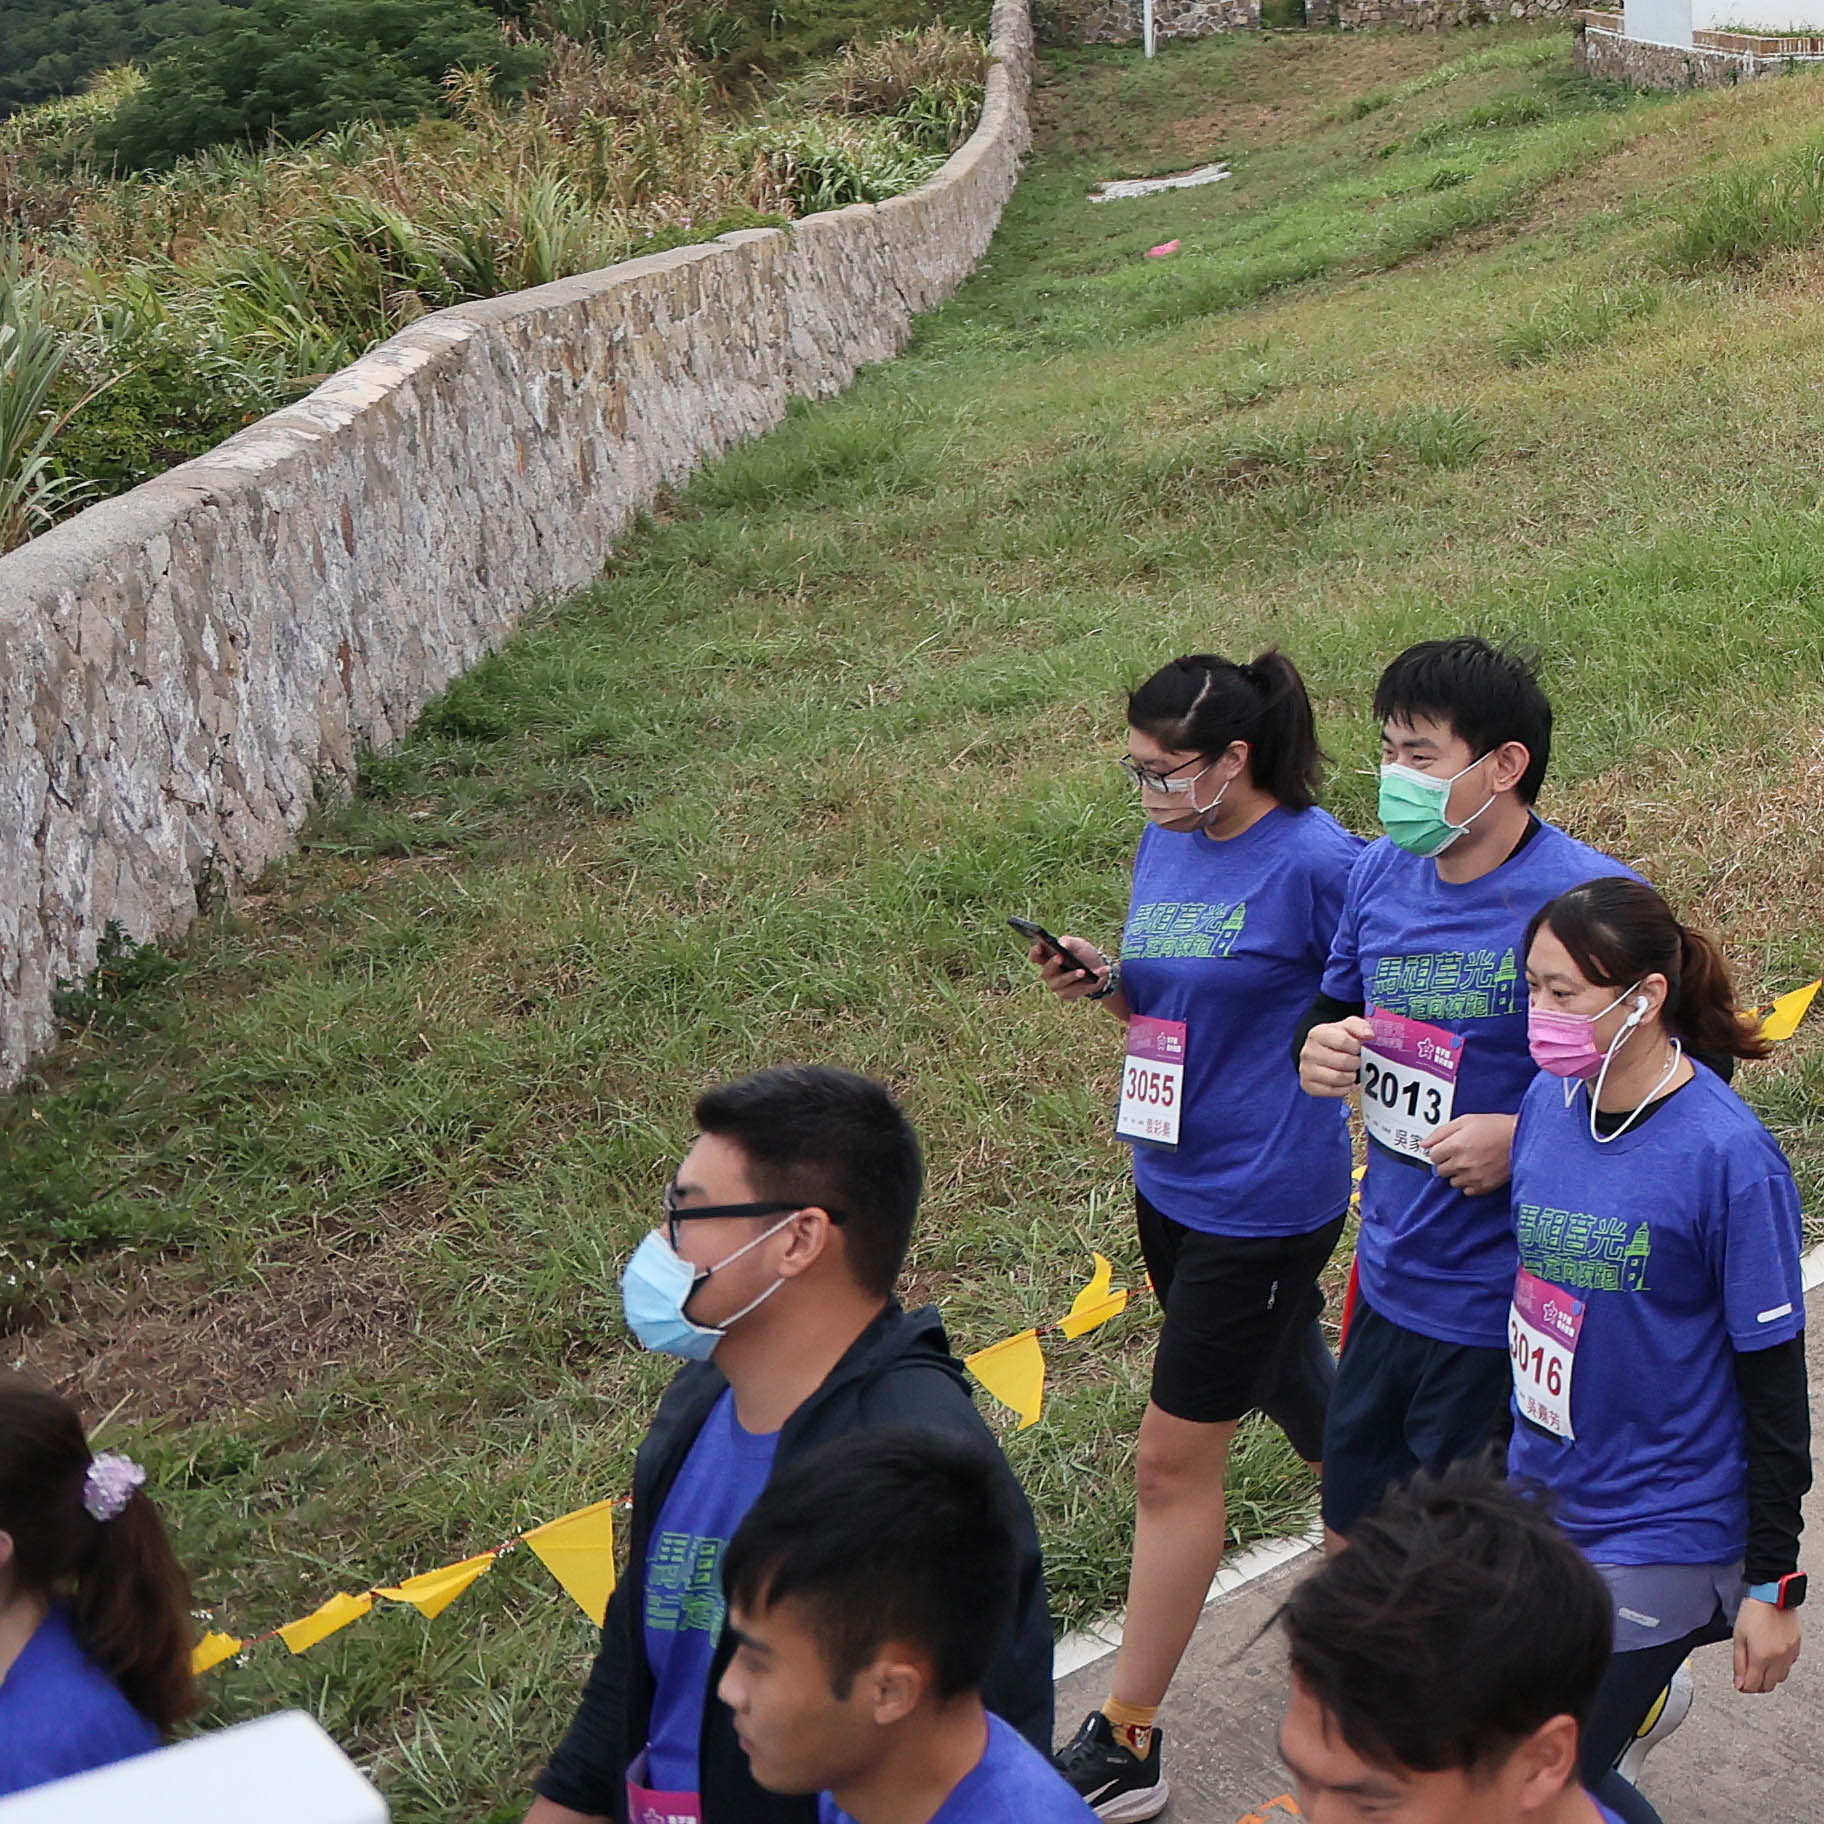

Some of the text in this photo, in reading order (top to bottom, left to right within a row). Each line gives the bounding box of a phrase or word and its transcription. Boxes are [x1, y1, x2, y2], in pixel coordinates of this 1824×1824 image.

[1373, 949, 1496, 995] 馬祖莒光
[1126, 1067, 1175, 1108] 3055
[1364, 1062, 1442, 1126] 2013
[1511, 1319, 1562, 1397] 3016
